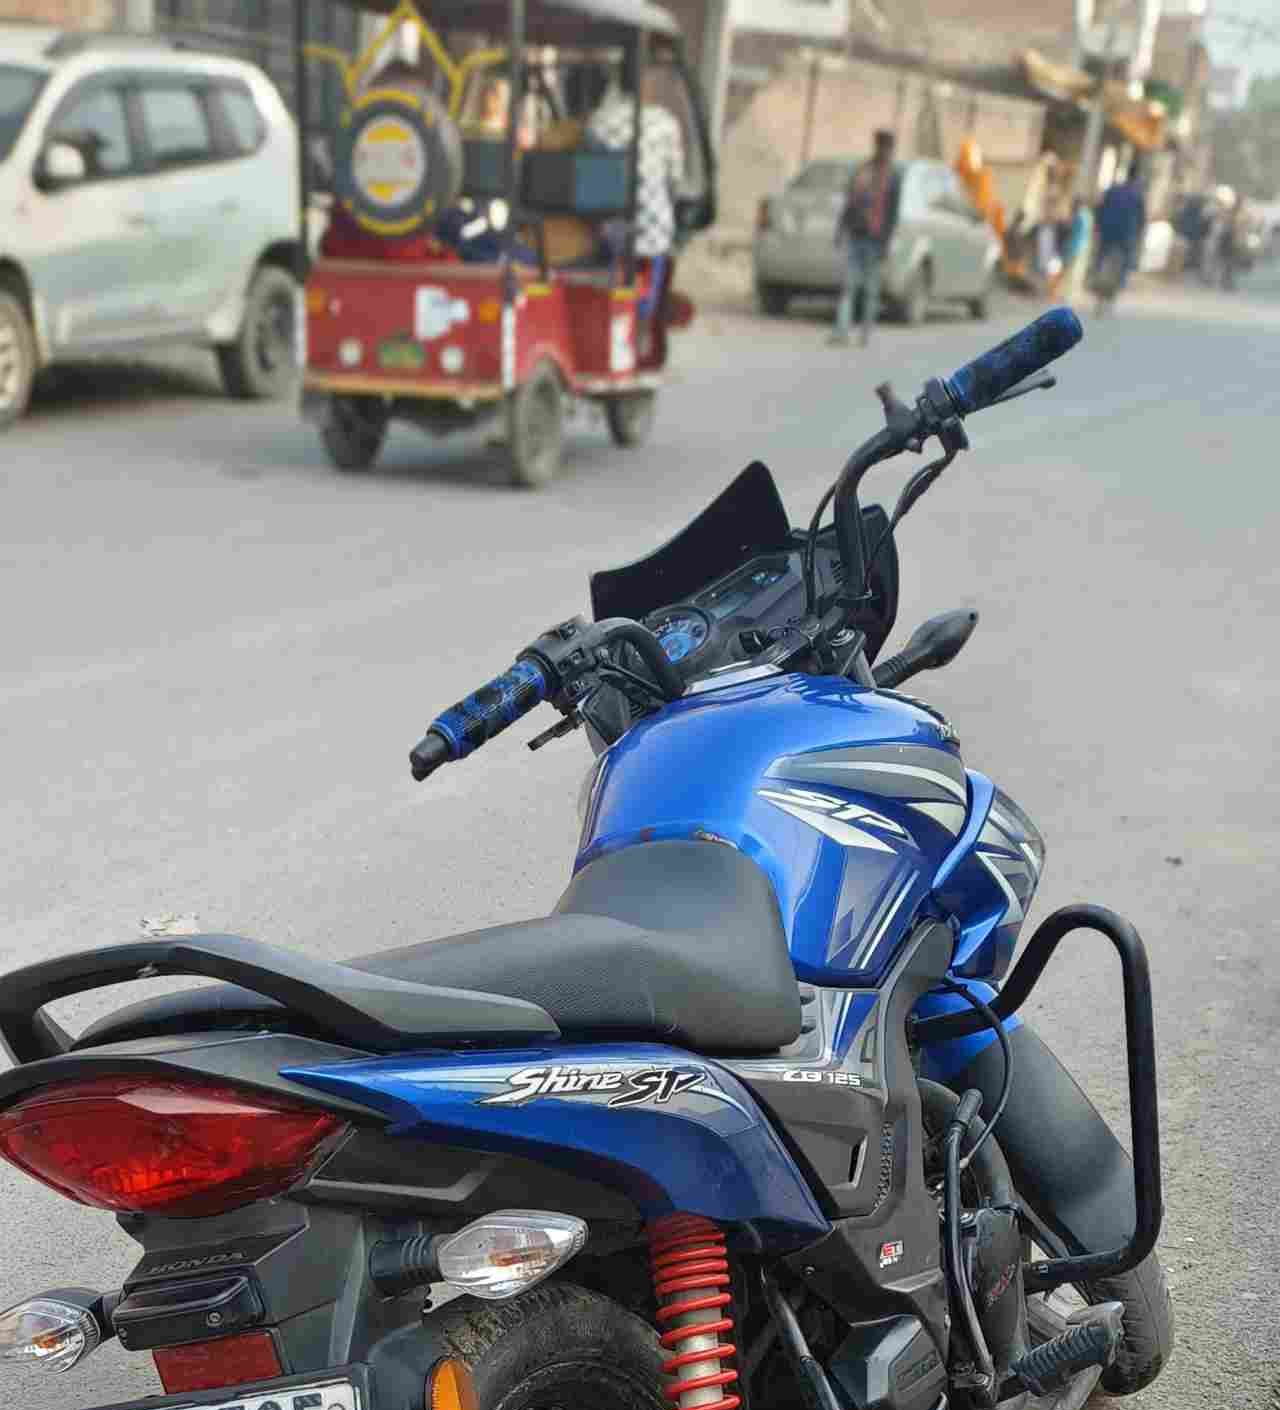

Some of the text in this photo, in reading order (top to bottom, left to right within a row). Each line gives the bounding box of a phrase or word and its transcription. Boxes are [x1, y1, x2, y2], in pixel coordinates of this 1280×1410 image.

[473, 1067, 707, 1108] Shine SP
[827, 1071, 862, 1086] 125
[148, 1251, 249, 1274] HONDA
